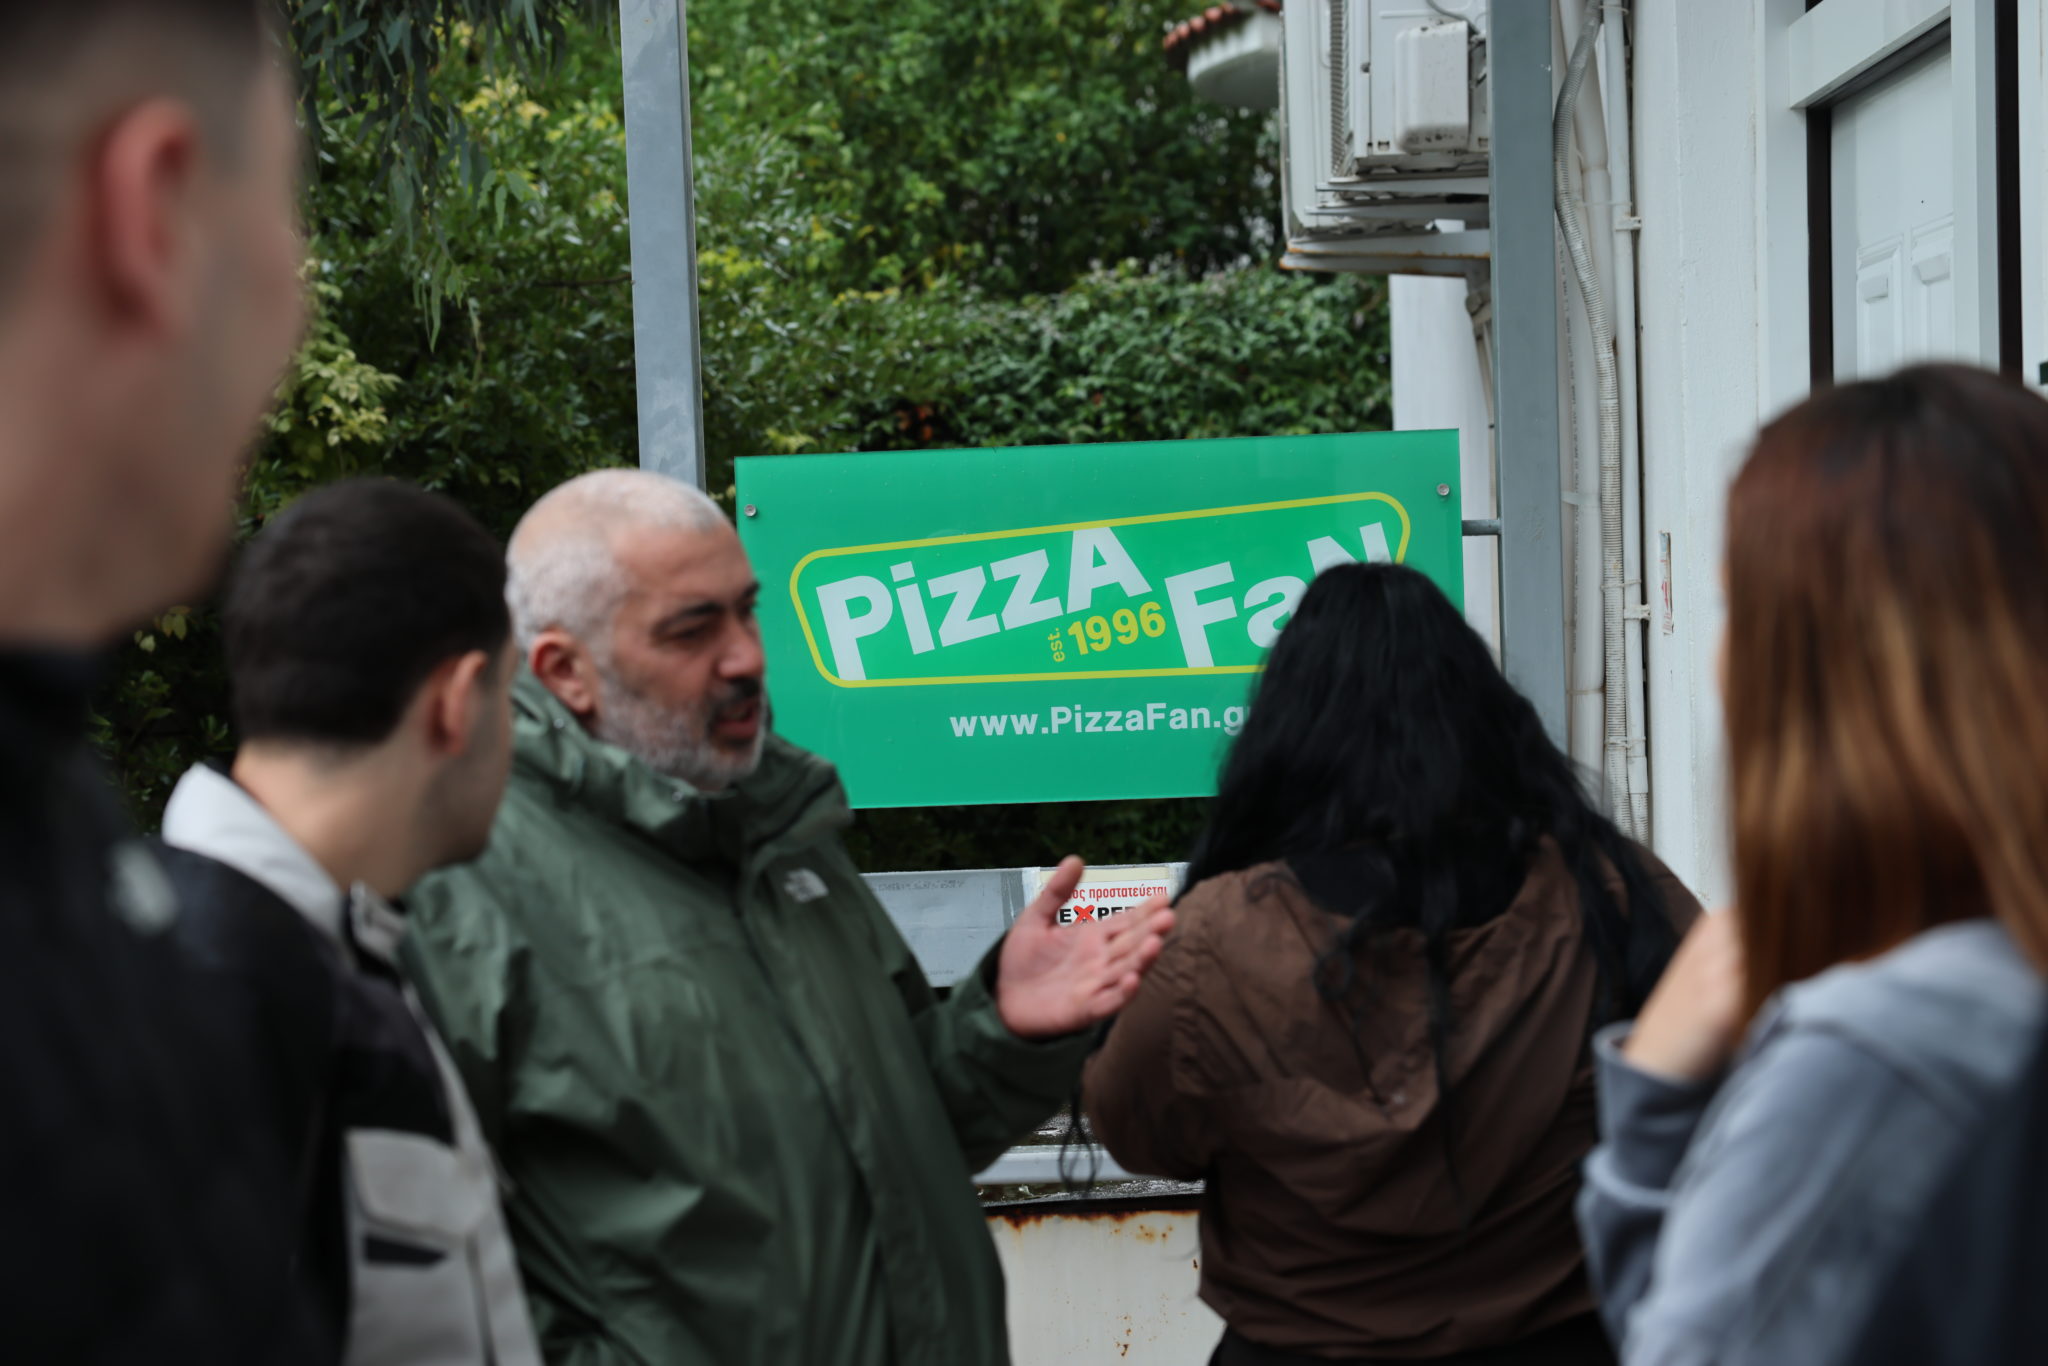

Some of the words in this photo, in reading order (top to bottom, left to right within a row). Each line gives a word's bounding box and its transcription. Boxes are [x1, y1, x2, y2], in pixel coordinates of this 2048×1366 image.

[1047, 627, 1066, 662] est.
[1067, 601, 1166, 656] 1996
[949, 703, 1250, 737] www.PizzaFan.g
[1071, 889, 1086, 902] ος
[1089, 883, 1168, 902] προστατεύεται
